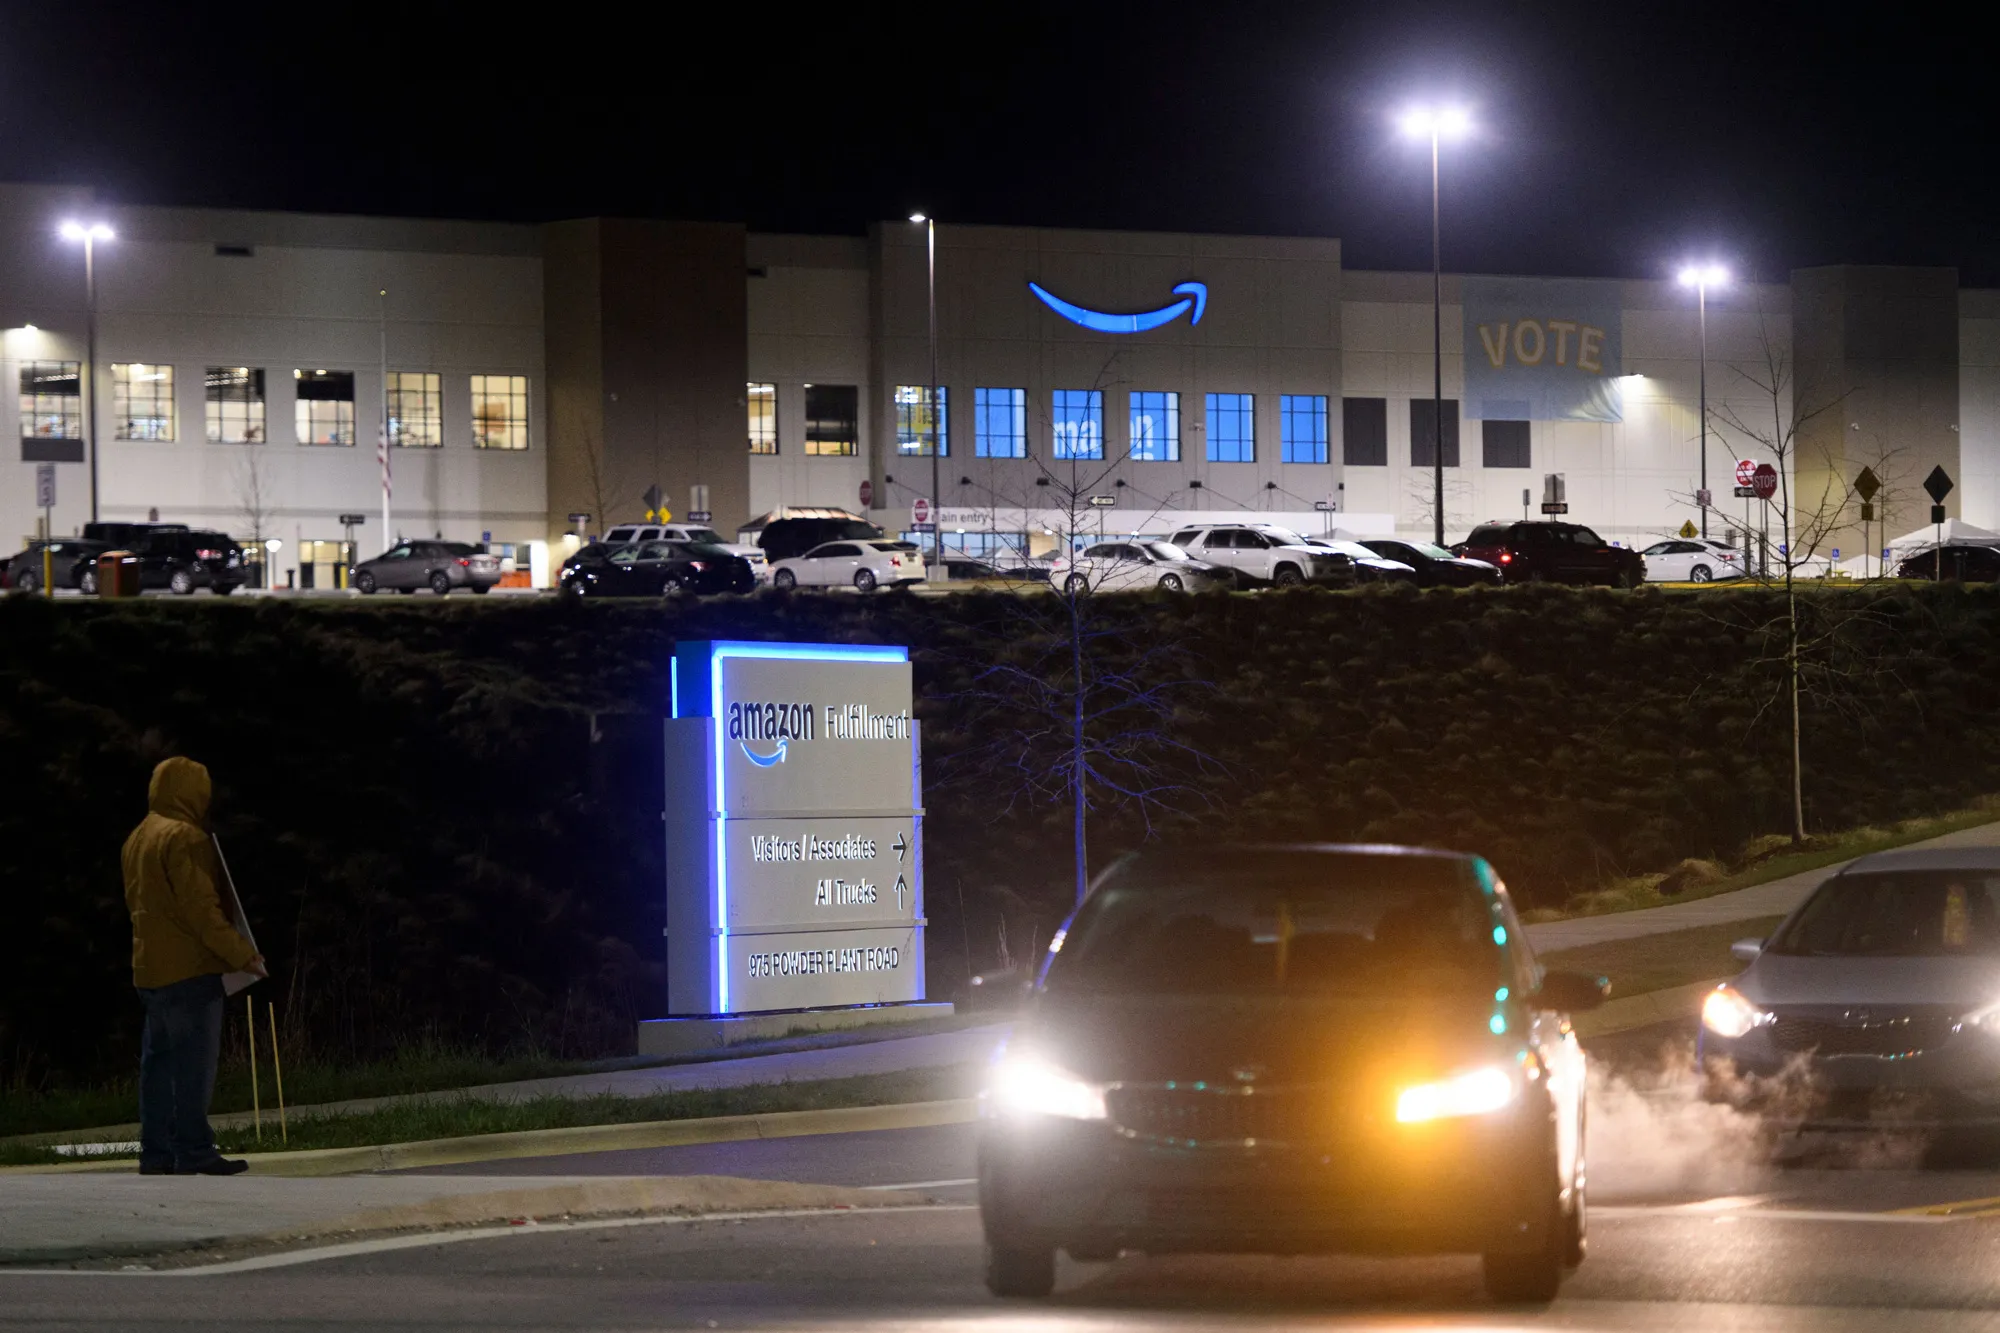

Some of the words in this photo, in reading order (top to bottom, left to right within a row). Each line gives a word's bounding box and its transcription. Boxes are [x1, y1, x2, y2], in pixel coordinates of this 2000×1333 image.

[1477, 317, 1606, 375] VOTE
[1754, 474, 1776, 489] STOP
[960, 512, 989, 525] entry
[728, 701, 814, 741] amazon
[824, 703, 910, 740] Fulfillment
[751, 835, 801, 862] Visitors
[808, 833, 877, 861] Associates
[814, 879, 834, 906] All
[835, 878, 878, 905] Trucks
[748, 953, 770, 978] 975
[771, 950, 824, 976] POWDER
[825, 948, 864, 973] PLANT
[865, 946, 900, 971] ROAD
